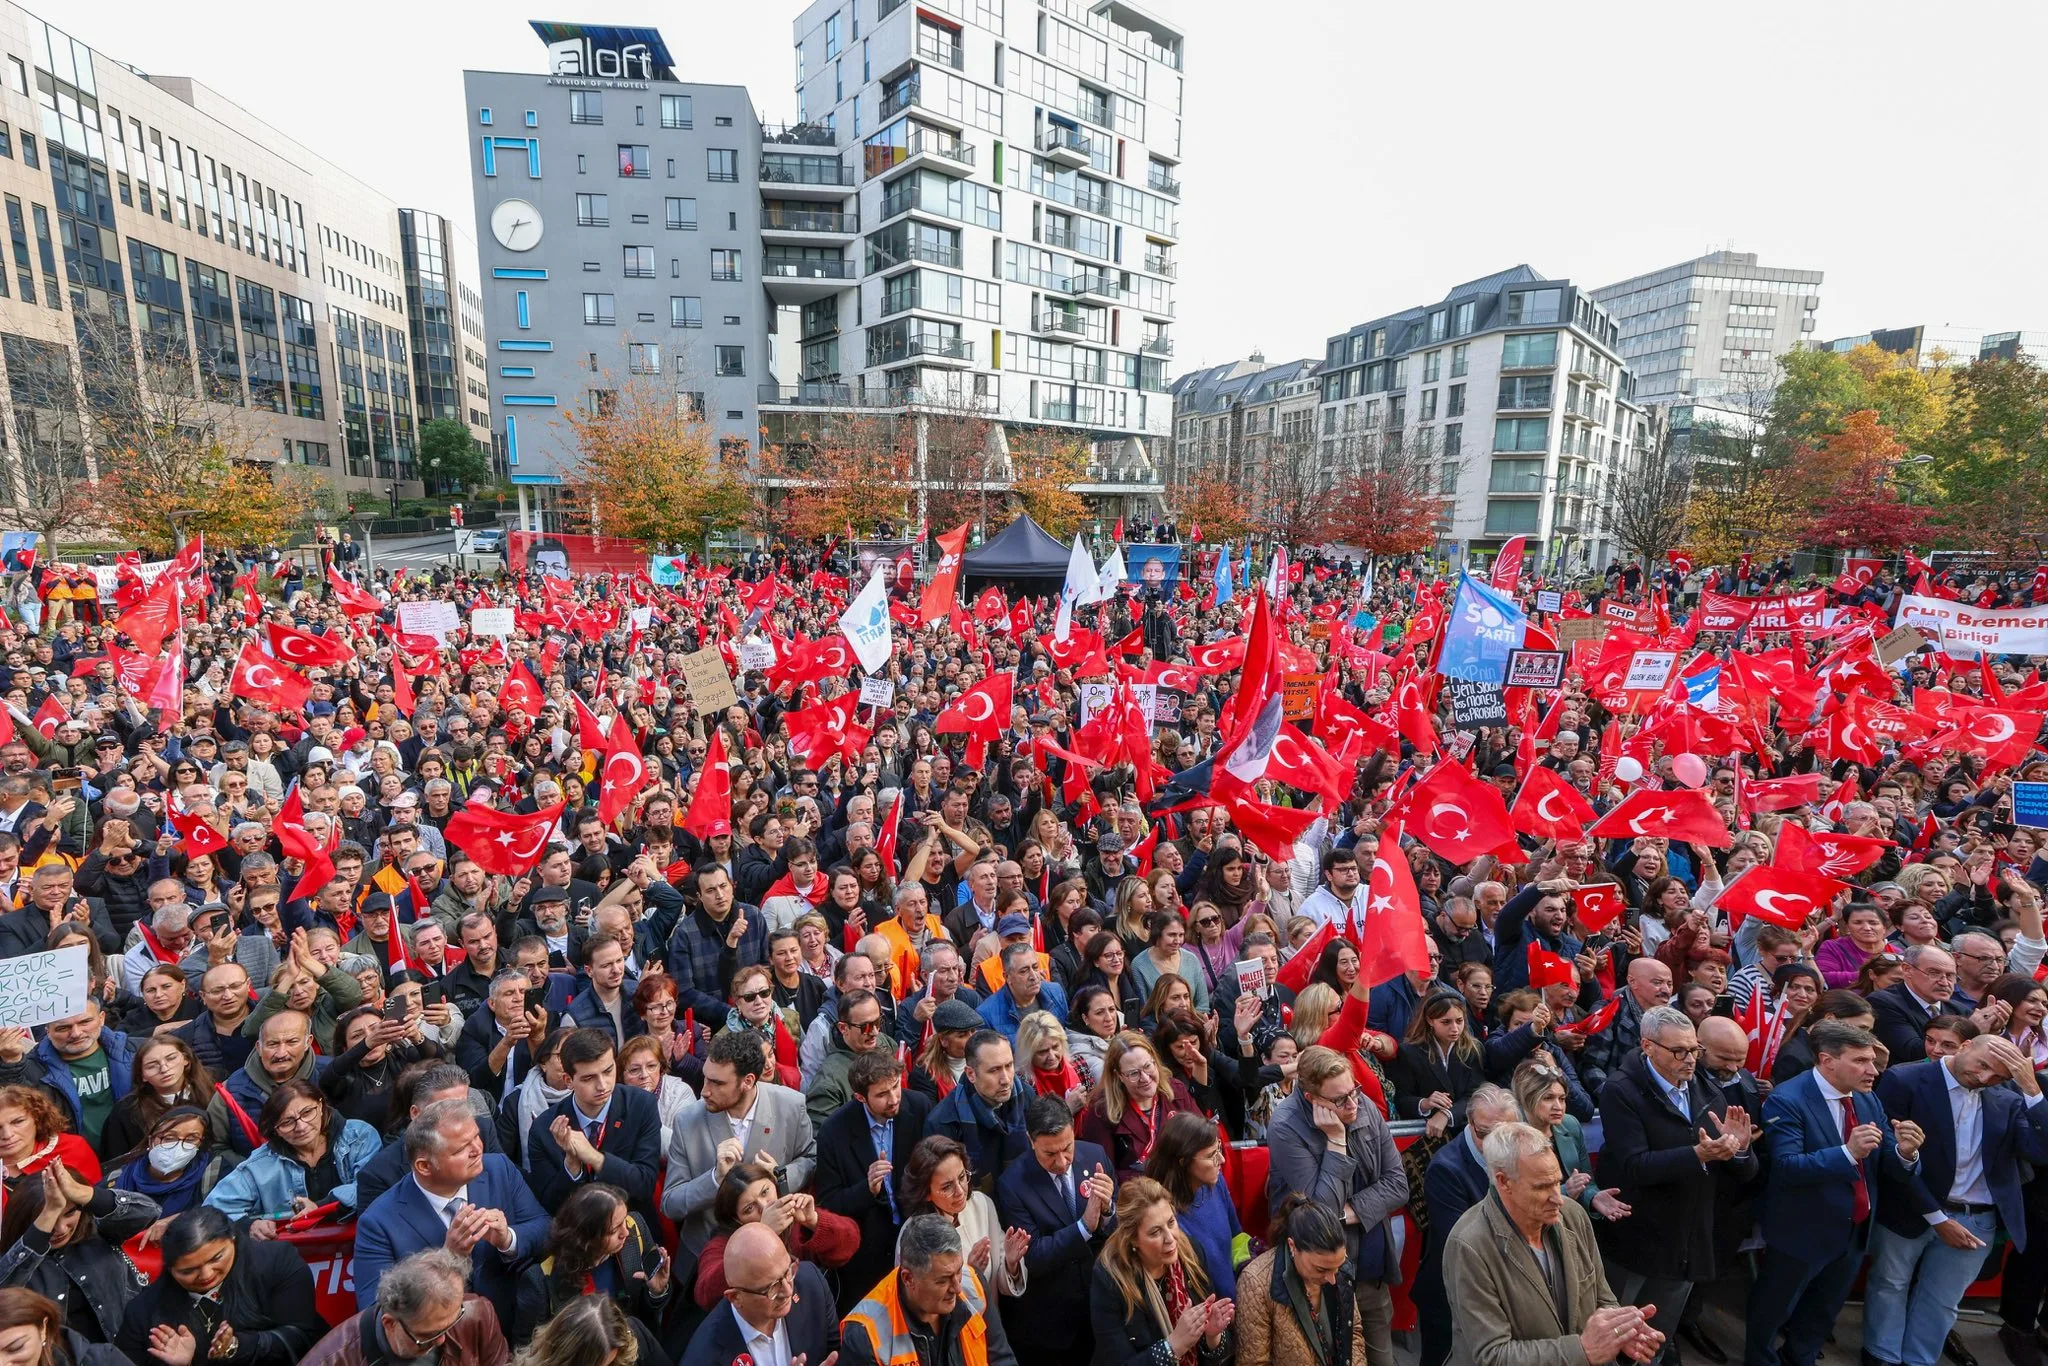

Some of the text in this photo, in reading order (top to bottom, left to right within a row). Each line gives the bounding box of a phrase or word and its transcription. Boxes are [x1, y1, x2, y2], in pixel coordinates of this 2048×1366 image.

[549, 37, 652, 80] aloft
[555, 79, 586, 87] VISION
[617, 81, 650, 90] HOTELS
[1608, 605, 1635, 619] CHP
[1703, 615, 1736, 627] CHP
[1750, 611, 1822, 628] BİRLĞİ
[120, 673, 141, 693] CHP
[1867, 719, 1907, 733] CHP
